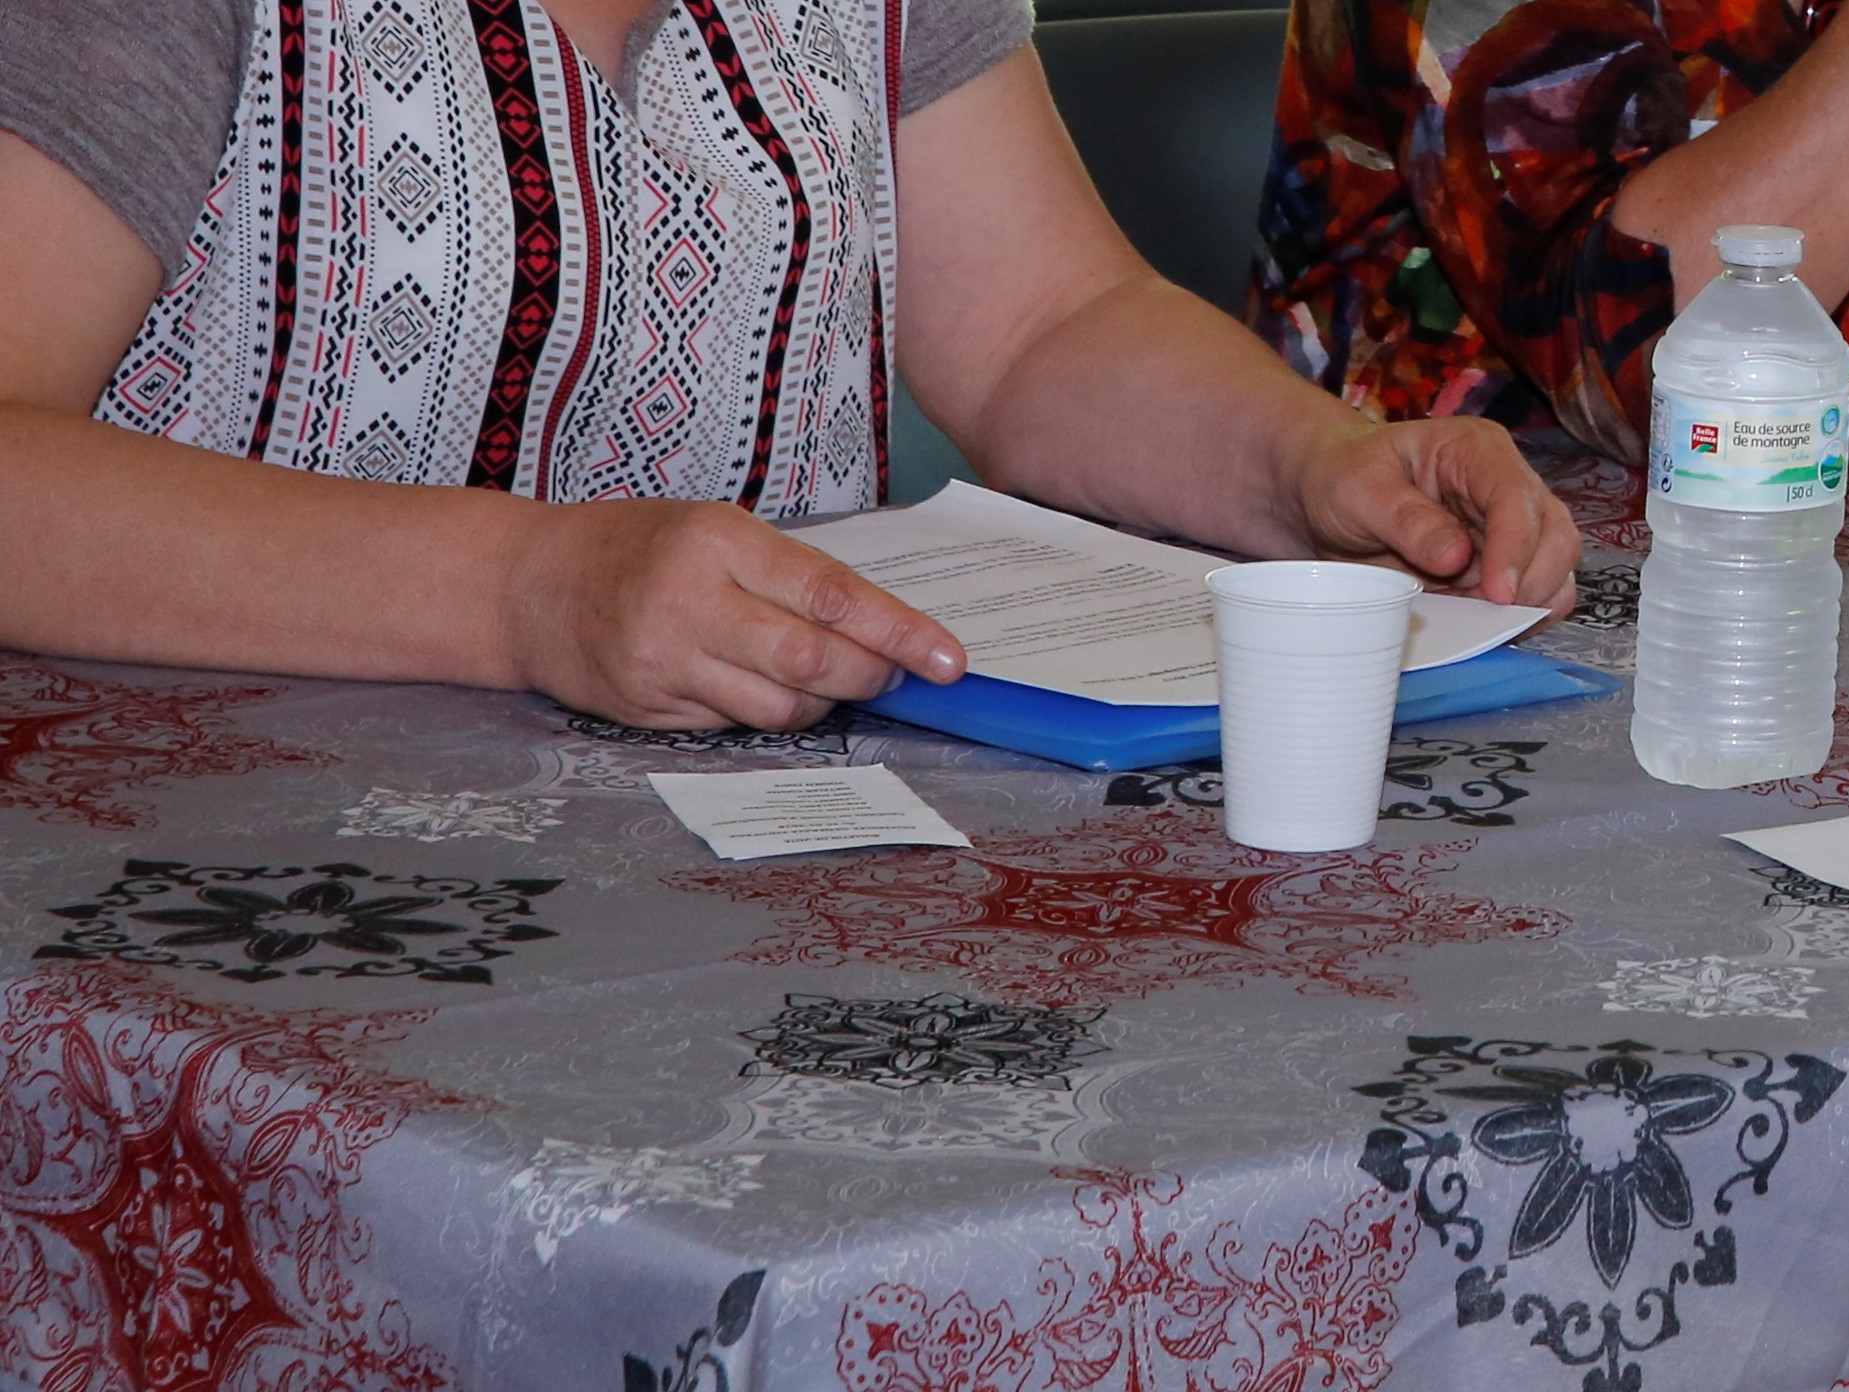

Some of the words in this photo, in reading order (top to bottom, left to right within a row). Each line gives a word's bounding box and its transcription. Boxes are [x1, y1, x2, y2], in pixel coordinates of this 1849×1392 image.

[1733, 421, 1758, 435] Eau
[1759, 422, 1774, 435] de
[1775, 421, 1811, 434] source
[1692, 434, 1717, 444] France
[1733, 434, 1749, 446] de
[1750, 433, 1811, 449] montagne
[1791, 486, 1804, 500] 50
[1805, 485, 1813, 498] cl
